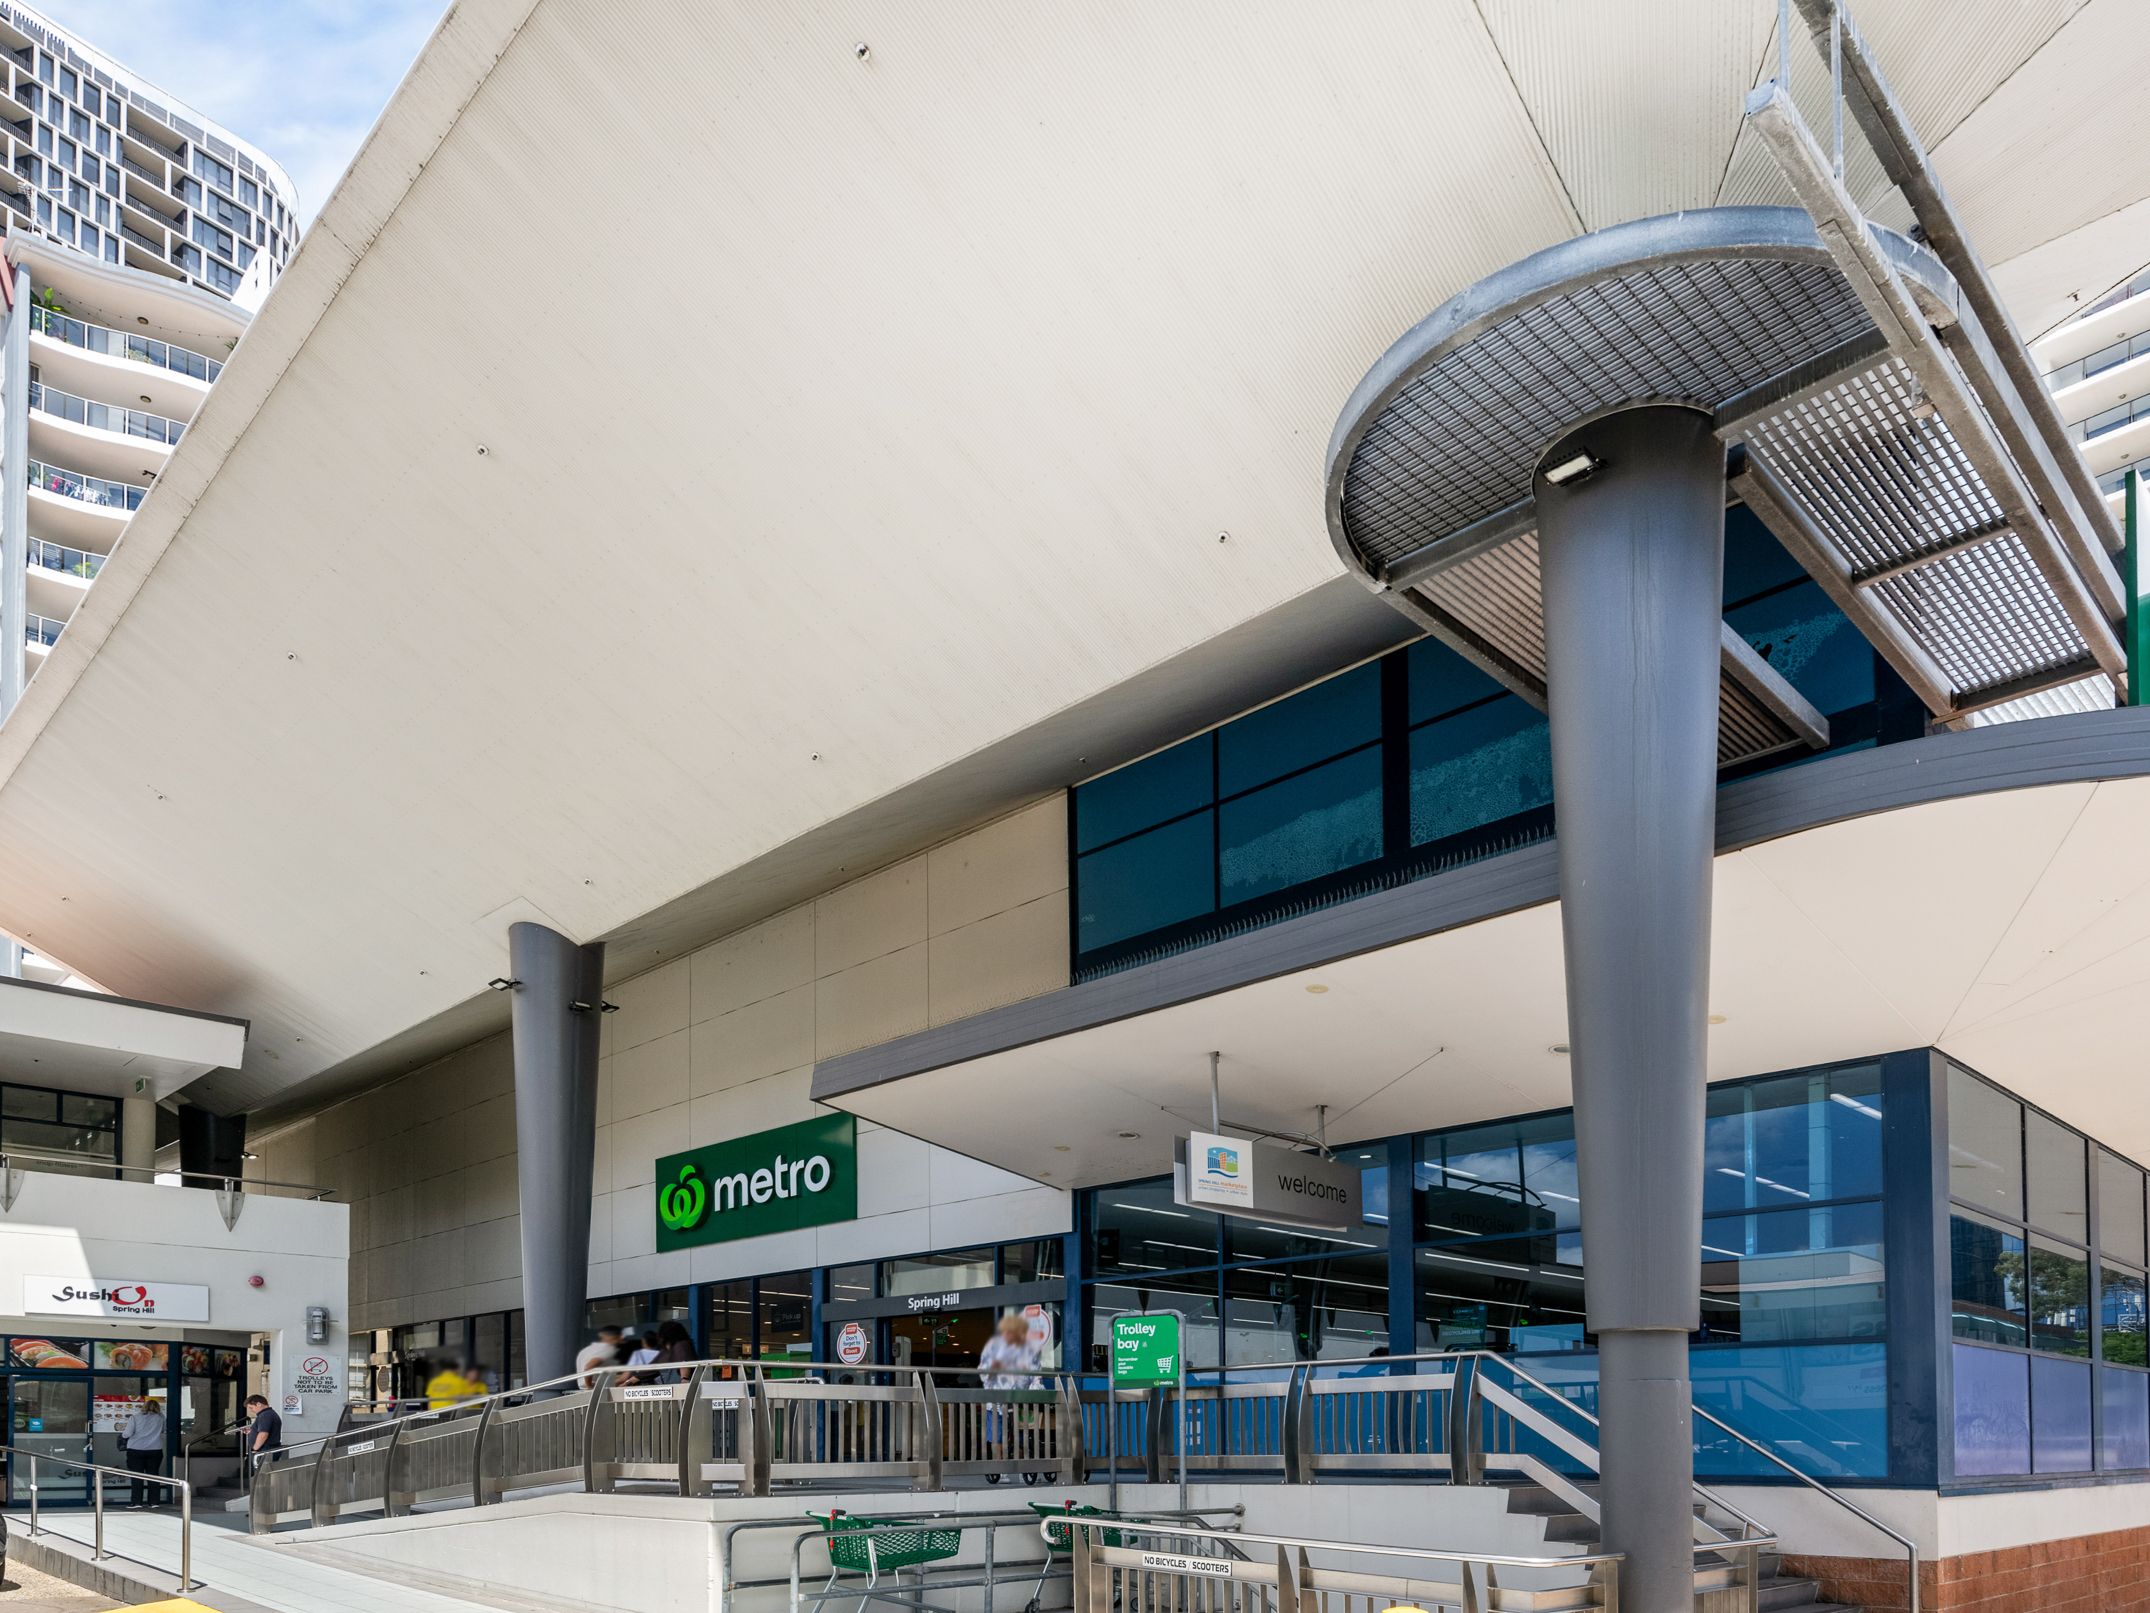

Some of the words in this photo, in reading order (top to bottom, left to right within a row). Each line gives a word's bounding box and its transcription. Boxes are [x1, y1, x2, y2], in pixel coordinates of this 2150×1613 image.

[714, 1154, 831, 1212] metro
[1277, 1174, 1347, 1204] welcome
[52, 1286, 120, 1302] Sushi
[908, 1297, 941, 1311] Spring
[942, 1292, 960, 1305] Hill
[112, 1305, 141, 1314] Spring
[1117, 1322, 1156, 1337] Trolley
[1117, 1338, 1139, 1352] bay
[651, 1388, 672, 1396] SCOOTERS
[1144, 1555, 1154, 1564] NO
[1156, 1557, 1187, 1569] BICYCLES
[1192, 1561, 1229, 1573] SCOOTERS
